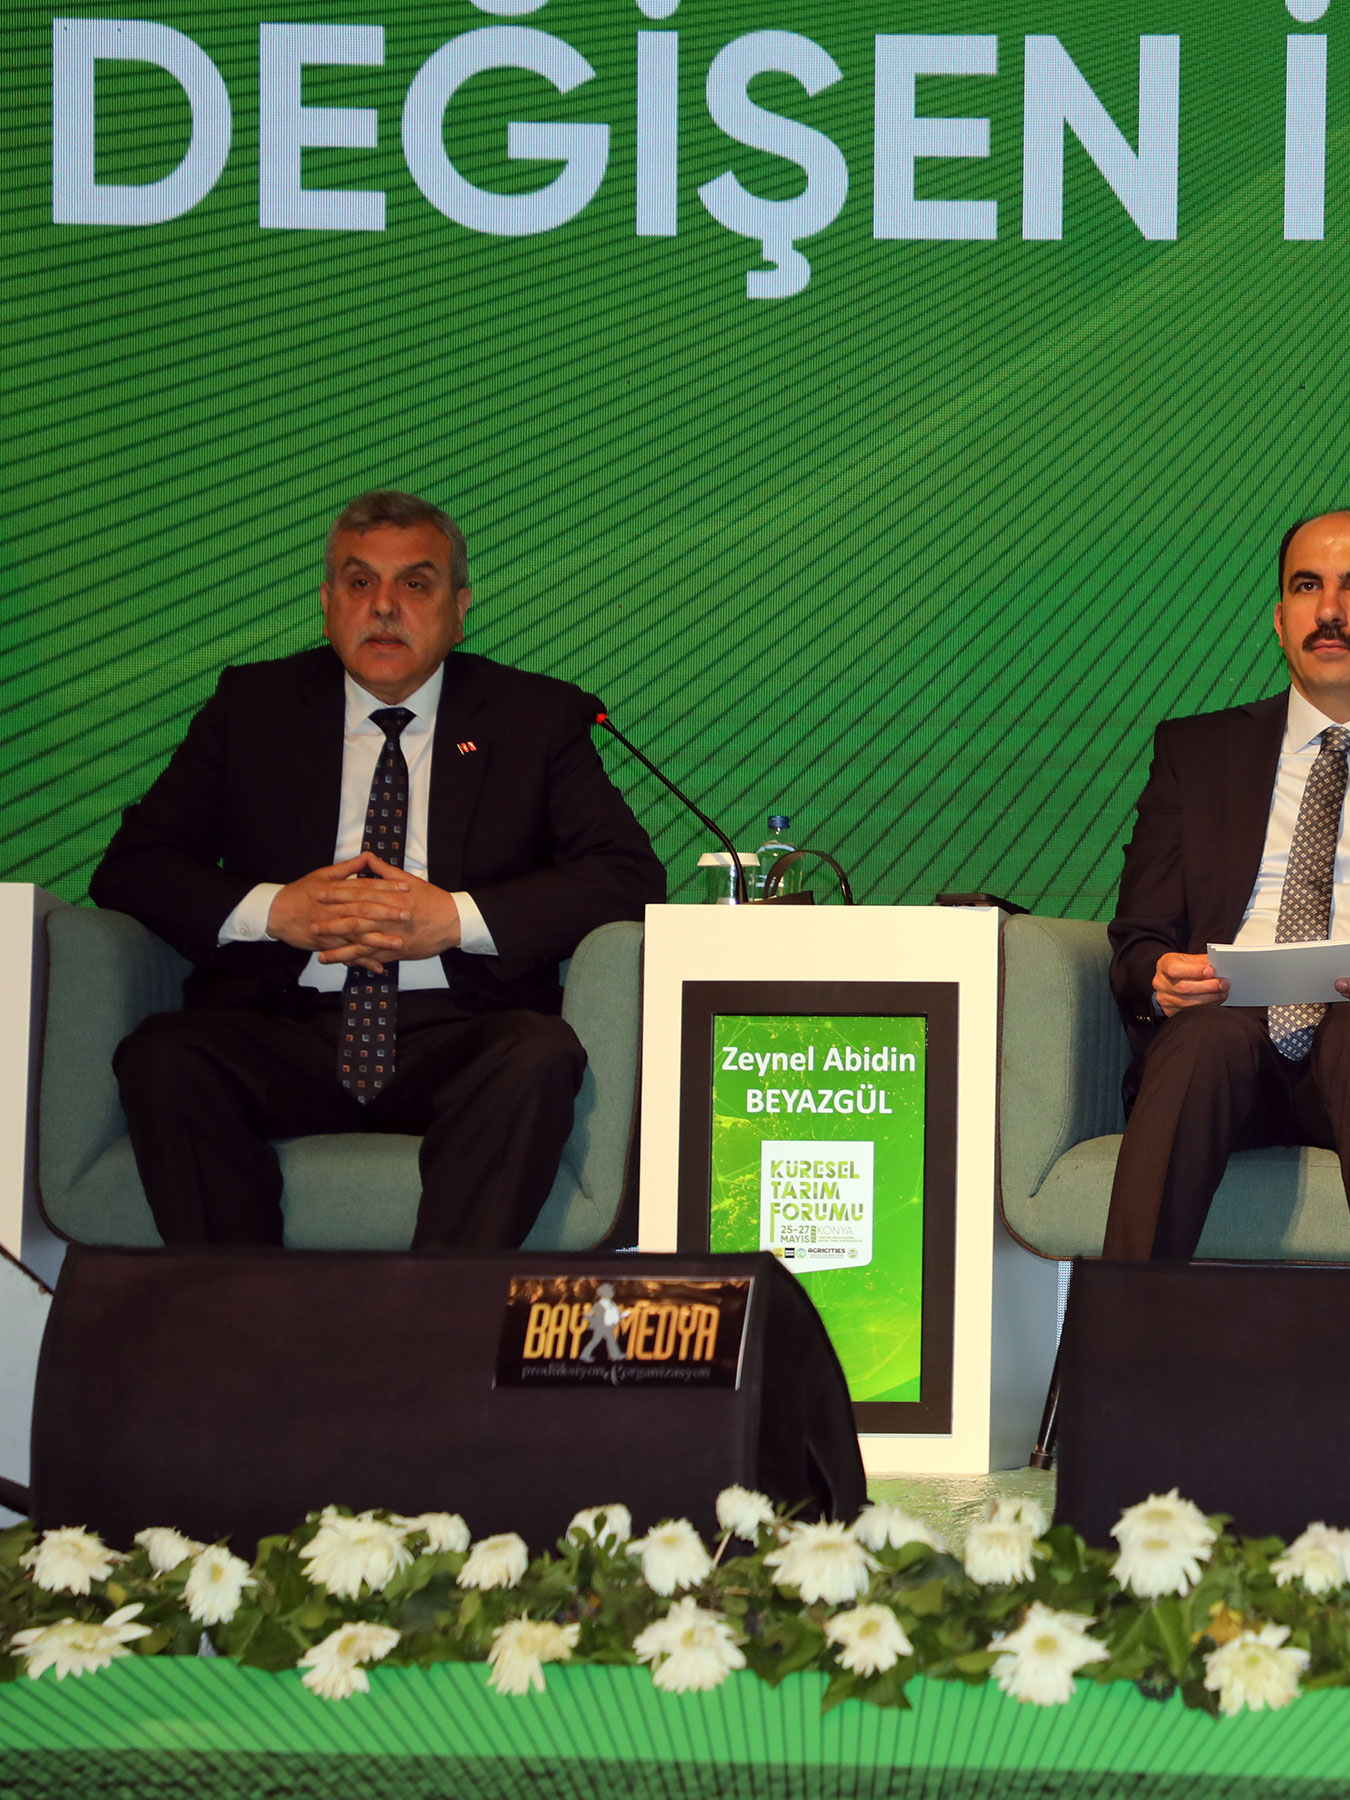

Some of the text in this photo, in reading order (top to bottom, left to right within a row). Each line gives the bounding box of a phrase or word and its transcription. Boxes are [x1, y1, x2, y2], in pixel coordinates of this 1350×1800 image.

[52, 0, 1181, 299] DEĞİŞEN
[721, 1045, 917, 1077] Zeynel Abidin
[746, 1083, 893, 1114] BEYAZGÜL
[770, 1160, 860, 1179] KÜRESEL
[771, 1181, 840, 1200] TARIM
[780, 1225, 853, 1235] 25-27 KONYA
[780, 1235, 810, 1243] MAYIS
[522, 1302, 591, 1359] BAY
